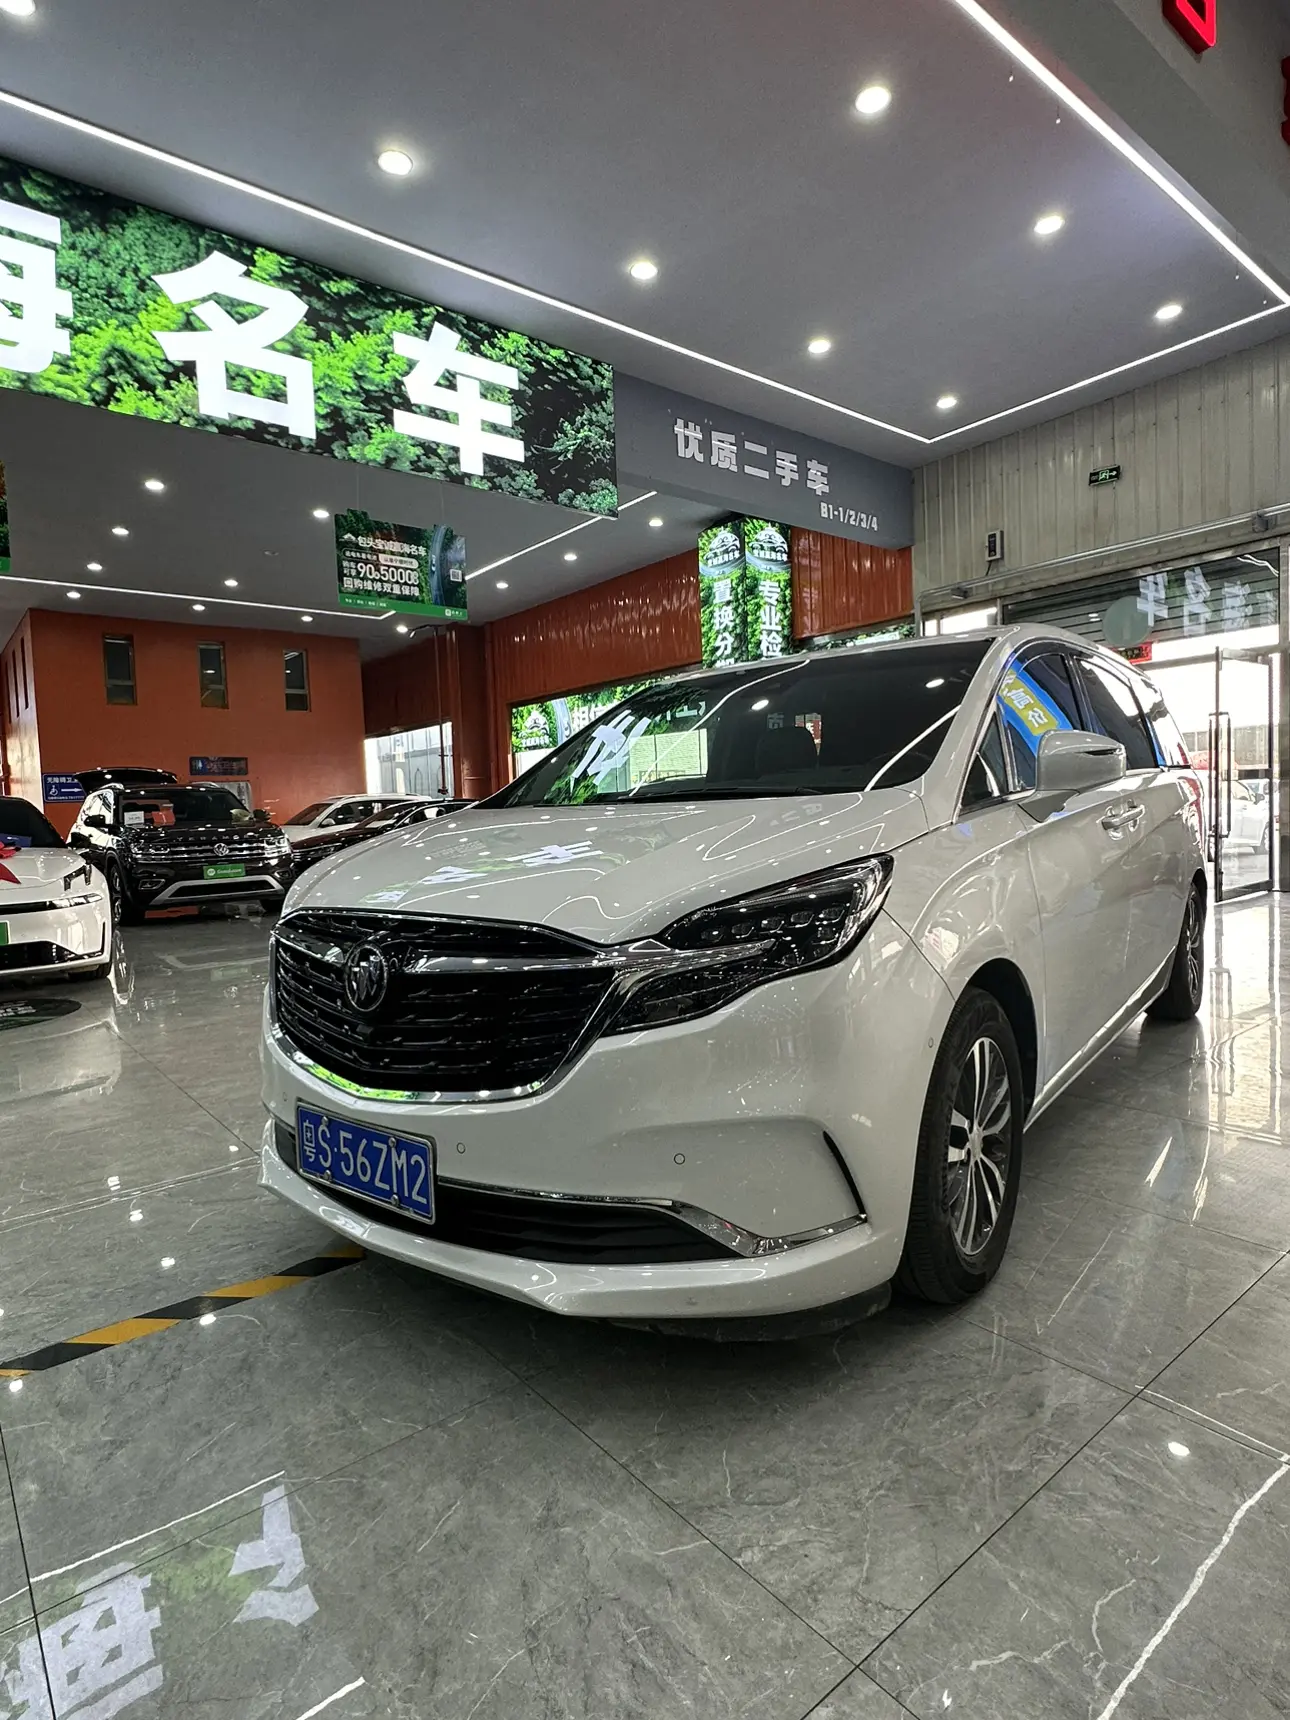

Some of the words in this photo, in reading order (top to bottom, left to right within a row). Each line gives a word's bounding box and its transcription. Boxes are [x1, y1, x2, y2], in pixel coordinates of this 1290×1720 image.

[674, 418, 829, 496] 优质二手车
[820, 502, 878, 531] B1-1/2/3/4
